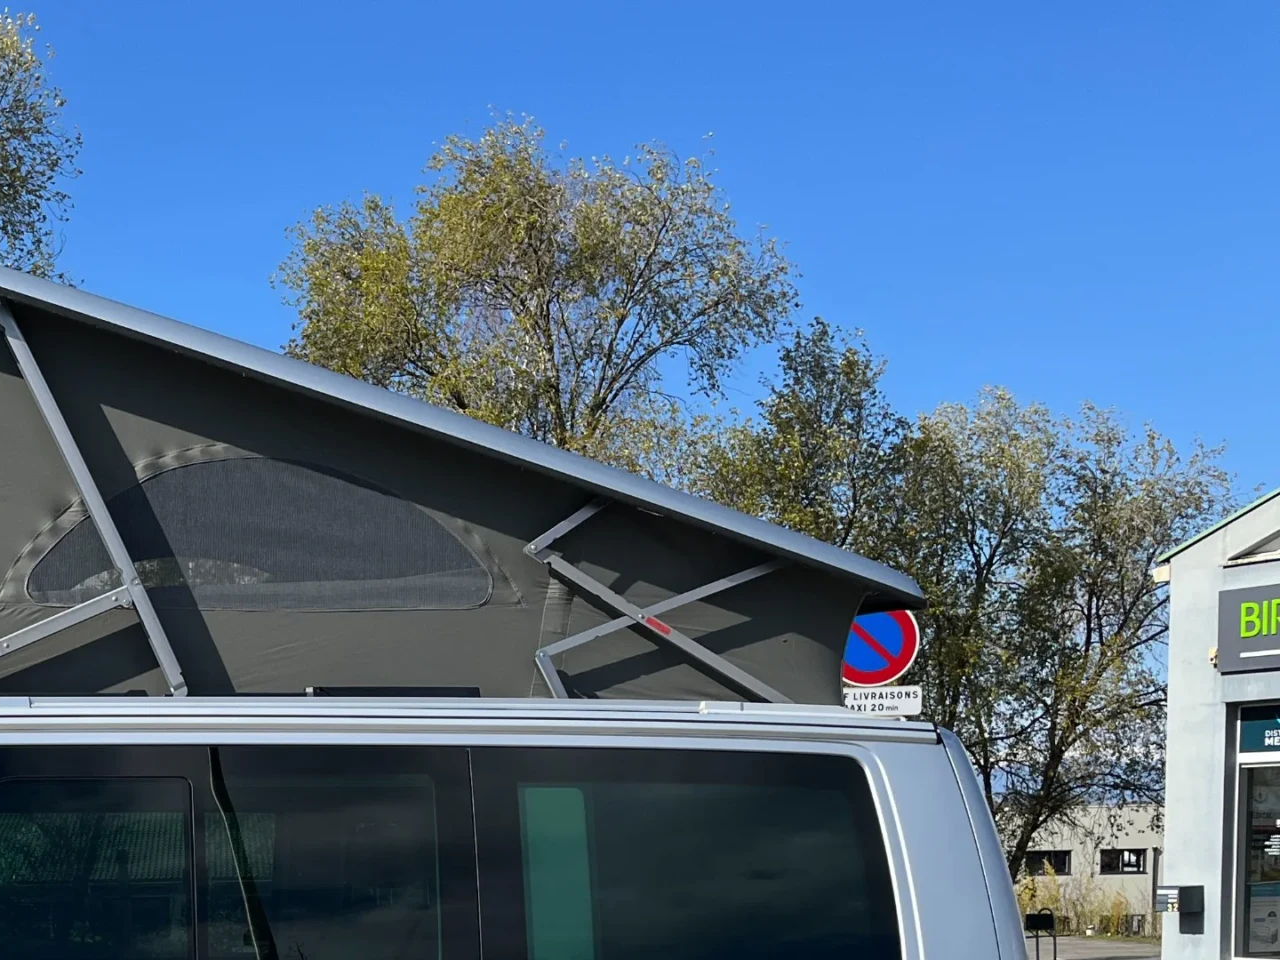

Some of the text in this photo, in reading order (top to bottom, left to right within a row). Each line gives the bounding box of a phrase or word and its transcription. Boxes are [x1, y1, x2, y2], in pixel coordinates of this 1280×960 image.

[853, 691, 919, 700] LIVRAISONS
[870, 703, 884, 712] 20
[885, 704, 899, 712] min
